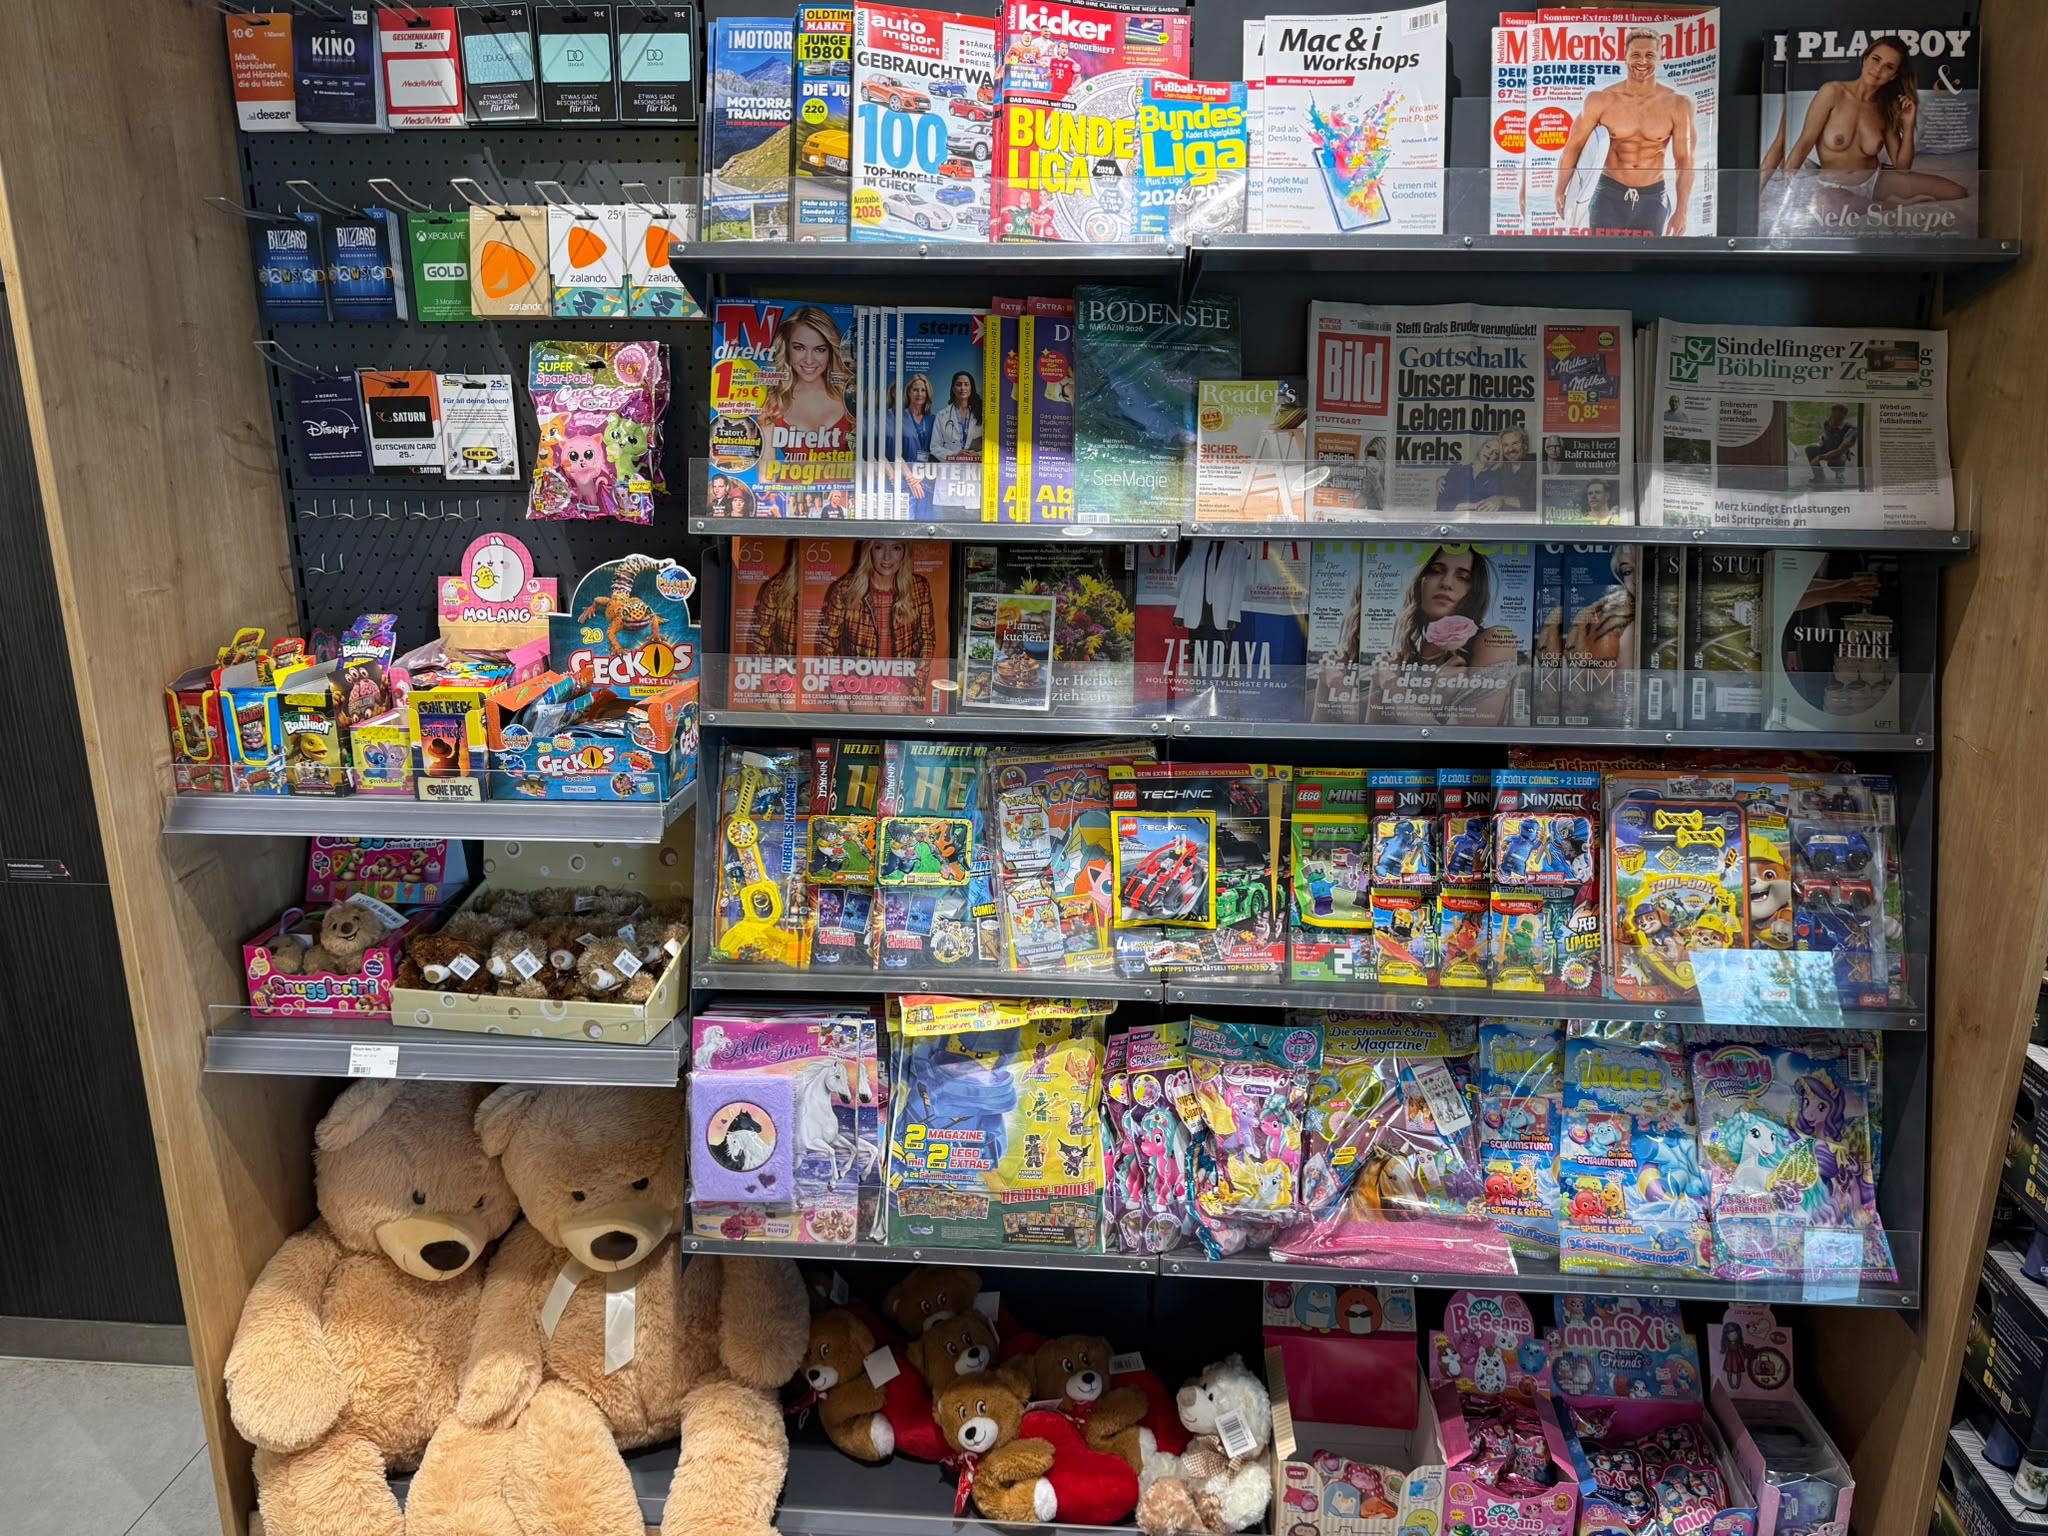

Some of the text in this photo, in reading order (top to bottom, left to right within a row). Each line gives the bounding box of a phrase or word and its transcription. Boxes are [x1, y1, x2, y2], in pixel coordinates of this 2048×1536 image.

[806, 21, 846, 31] MARKT
[871, 16, 926, 34] auto
[1019, 4, 1111, 41] kicker
[393, 33, 444, 41] GESCHENKKARTE
[882, 29, 936, 45] motor
[1279, 26, 1382, 52] Mac & i
[312, 37, 355, 56] KINO
[805, 47, 843, 59] 1980
[901, 42, 941, 57] sport
[1069, 42, 1115, 54] SONDERHEFT
[236, 62, 276, 70] Hörbücher
[1303, 53, 1419, 73] Workshops
[1663, 53, 1716, 70] Verstehst du
[1533, 65, 1621, 75] DEIN BESTER
[1533, 76, 1595, 85] SOMMER
[1154, 81, 1228, 96] Fußball-Timer
[1532, 87, 1548, 96] 67
[257, 109, 291, 120] deezer
[804, 105, 824, 113] 220
[1409, 104, 1439, 113] Kreativ
[858, 104, 948, 175] 100
[1268, 134, 1302, 143] Desktop
[864, 165, 944, 185] TOP-MODELLE
[1008, 149, 1092, 196] LIGA
[863, 177, 916, 192] IM CHECK
[1267, 177, 1289, 185] Apple
[1267, 185, 1302, 194] meistern
[1392, 190, 1437, 199] Goodnotes
[855, 206, 882, 218] 2026
[267, 230, 307, 250] BLIZZARD
[336, 227, 376, 247] BLIZZARD
[427, 266, 464, 278] GOLD
[570, 274, 606, 283] zalando
[509, 303, 544, 311] zalando
[1090, 300, 1231, 329] BODENSEE
[918, 320, 970, 336] stern
[715, 340, 776, 362] direkt
[990, 322, 998, 380] STUDIENFÜHRER
[1717, 337, 1845, 360] Sindelfinger
[1400, 346, 1528, 368] Gottschalk
[538, 362, 573, 372] SUPER
[1323, 339, 1384, 403] Bild
[1717, 357, 1833, 384] Böblinger
[537, 373, 592, 385] Spar-Pack
[1398, 370, 1535, 398] Unser neues
[1221, 404, 1259, 417] Digest
[1719, 401, 1758, 409] Einbrechern
[392, 412, 426, 422] SATURN
[1315, 416, 1361, 425] STUTTGART
[719, 429, 744, 437] Tatort
[772, 426, 840, 448] Direkt
[714, 437, 760, 446] Deutschland
[1573, 441, 1616, 449] Das Herz!
[784, 449, 855, 463] zum besten
[1200, 445, 1238, 454] SICHER
[1395, 437, 1462, 464] Krebs
[1564, 450, 1616, 459] Ralf Richter
[1093, 470, 1167, 490] SeeMagie
[948, 483, 975, 497] FÜR
[1715, 501, 1850, 516] Merz kündigt Entlastungen
[1715, 514, 1806, 528] bei Spritpreisen an
[739, 542, 764, 562] 65
[806, 542, 832, 562] 65
[1377, 562, 1392, 571] Der
[1368, 570, 1401, 579] Feelgood-
[657, 578, 695, 590] PLANET
[1374, 580, 1394, 588] Glow
[462, 607, 531, 623] MOLANG
[1007, 620, 1041, 631] Pfann-
[1794, 626, 1891, 645] STUTTGART
[343, 645, 389, 658] BRAINROT
[1569, 652, 1592, 660] LOUD
[1839, 643, 1892, 659] FEIERT
[568, 641, 695, 687] GECKOS
[1163, 639, 1270, 680] ZENDAYA
[1589, 660, 1617, 668] PROUD
[803, 659, 916, 677] THE POWER
[802, 676, 901, 694] OF COLOR
[1146, 677, 1287, 689] HOLLYWOODS STYLISHSTE FRAU
[1397, 673, 1507, 690] das schöne
[1569, 670, 1614, 692] KIM
[1382, 689, 1442, 705] Leben
[284, 721, 333, 735] BRAINROT
[818, 760, 827, 799] NINJAGO
[1379, 776, 1403, 785] COOLE
[1405, 776, 1434, 785] COMICS
[1114, 789, 1213, 800] LEGO TECHNIC
[1522, 792, 1587, 810] NINJAGO
[782, 777, 797, 873] RUBBLES HAMMER
[1121, 822, 1188, 832] LEGO TECHNIC
[1649, 879, 1717, 895] TOOL-BOX
[1578, 917, 1597, 932] AB
[1563, 969, 1589, 978] COMIC
[269, 976, 377, 1000] Snugglerini
[1194, 1028, 1227, 1045] SUPER
[1329, 1028, 1438, 1039] Die schönsten Extras
[1132, 1043, 1171, 1053] Magischer
[1131, 1053, 1173, 1066] SPAR-Pack
[905, 1124, 984, 1143] 2 MAGAZINE
[1490, 1141, 1553, 1151] SCHAUMSTURM
[951, 1148, 980, 1159] LEGO
[950, 1160, 990, 1170] EXTRAS
[1577, 1156, 1637, 1168] SCHAUMSTURM
[1564, 1315, 1670, 1351] miniXi
[1489, 1504, 1518, 1519] FUNNY
